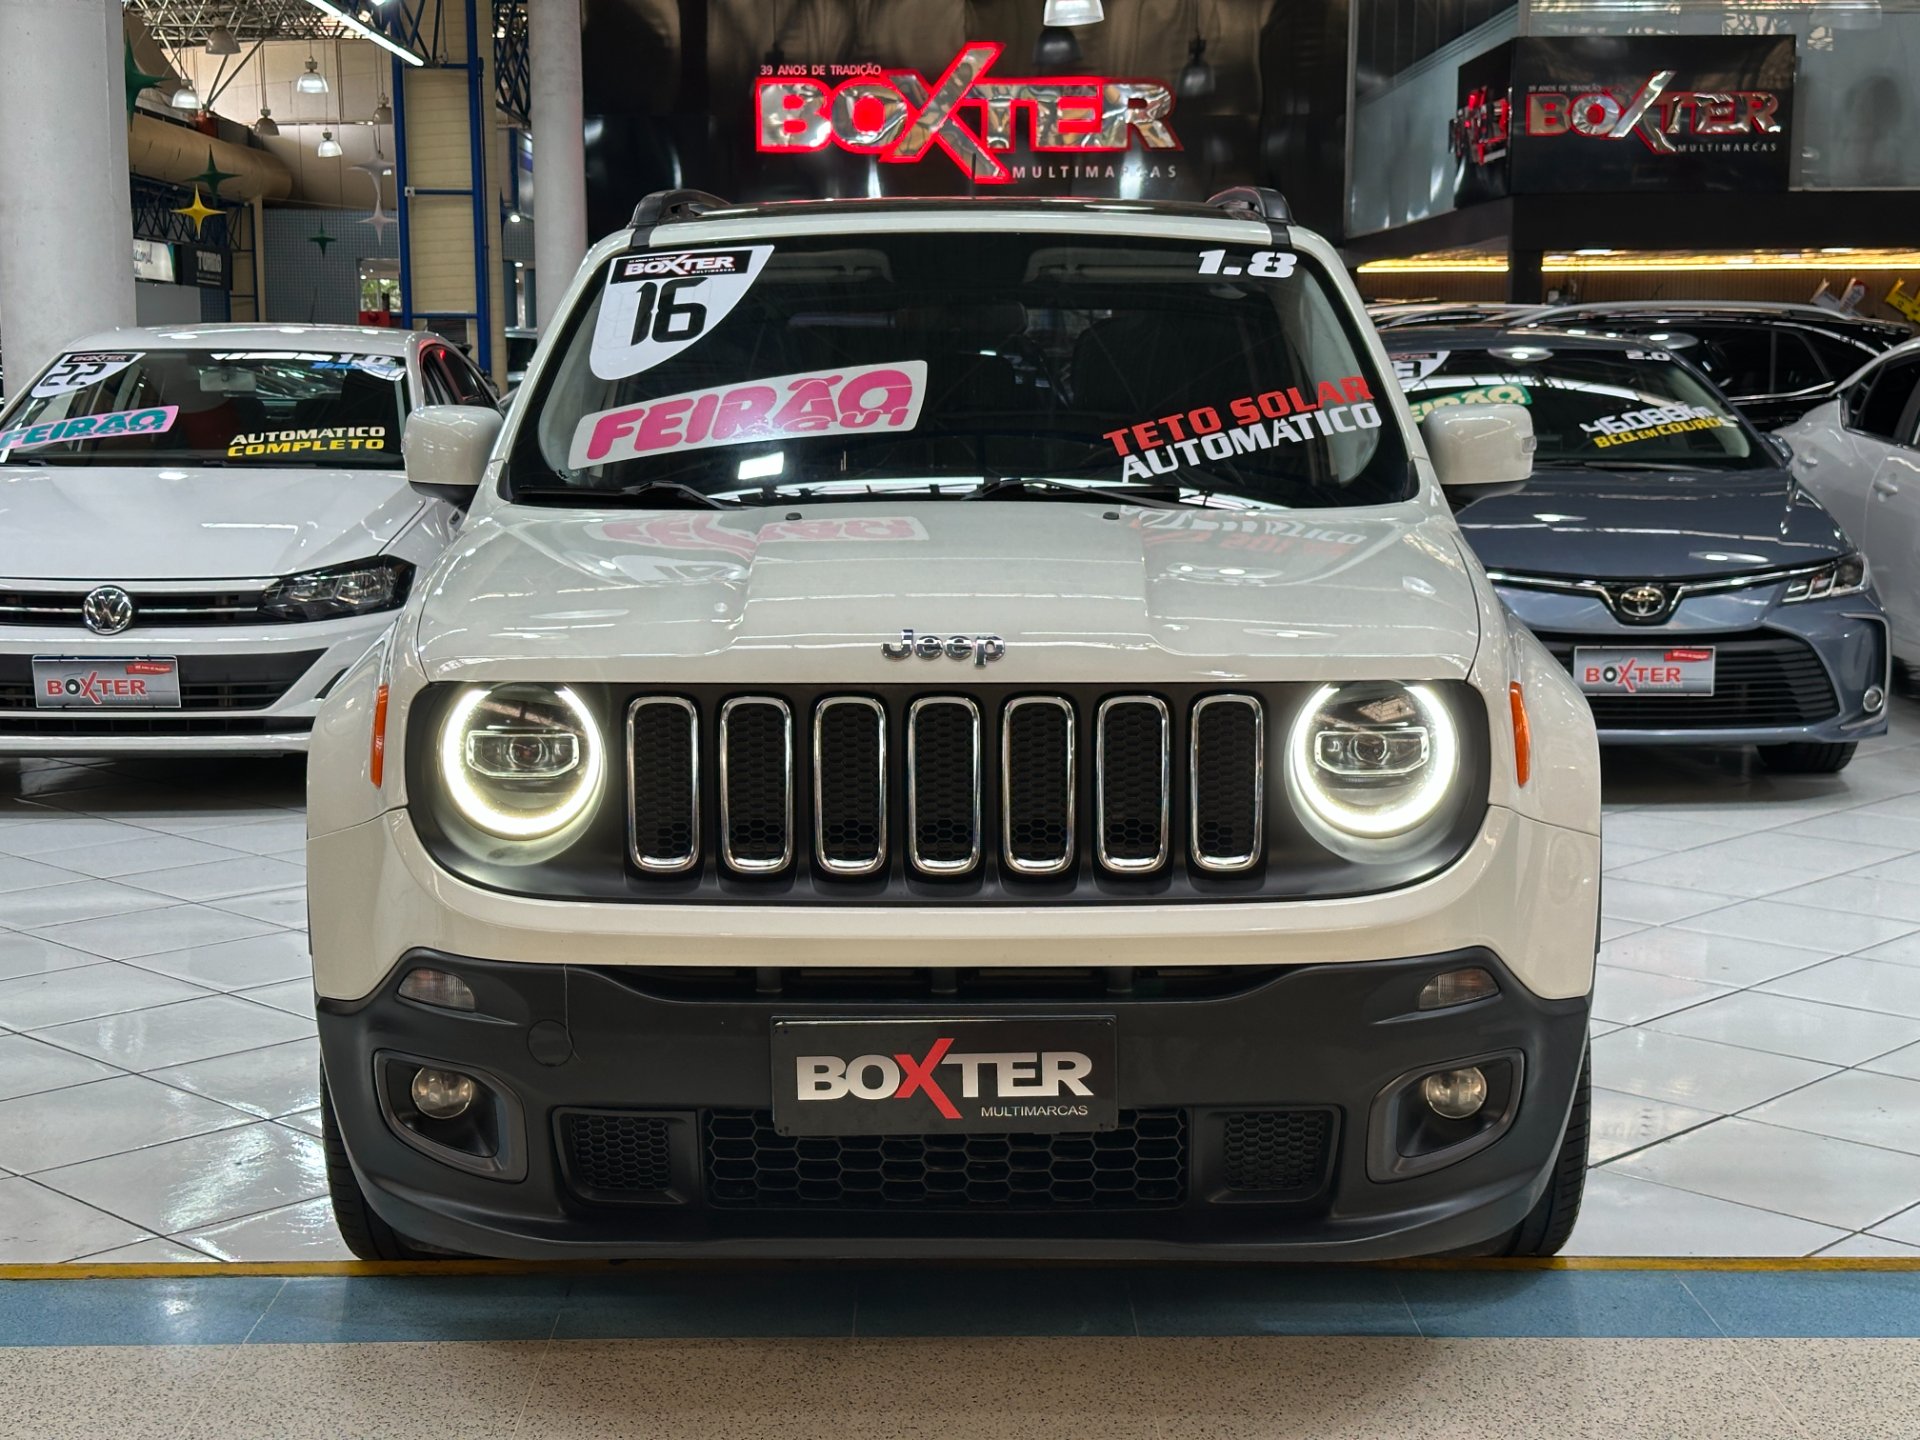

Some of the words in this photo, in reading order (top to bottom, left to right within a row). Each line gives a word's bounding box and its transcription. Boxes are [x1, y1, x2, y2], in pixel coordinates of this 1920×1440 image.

[760, 64, 773, 76] 39
[777, 64, 807, 76] ANOS
[811, 64, 826, 76] DE
[830, 62, 882, 77] TRADIÇÃO
[756, 41, 1184, 184] BOXTER
[1526, 70, 1782, 154] BOXTER
[1677, 142, 1777, 152] MULTIMARCAS
[623, 253, 736, 276] BOXTER
[1198, 249, 1298, 278] 1.8
[631, 276, 709, 347] 16
[1626, 350, 1671, 361] 2.0
[40, 363, 107, 387] 22
[0, 409, 167, 449] FEIRÃO
[587, 368, 913, 460] FEIRÃO
[1103, 406, 1222, 456] TETO
[1230, 376, 1375, 426] SOLAR
[1656, 416, 1723, 436] COURO
[227, 438, 385, 457] COMPLETO
[880, 629, 1006, 667] Jeep
[46, 671, 148, 705] BOXTER
[1584, 657, 1682, 692] BOXTER
[796, 1038, 1095, 1119] BOXTER
[980, 1104, 1089, 1117] MULTIMARCAS
